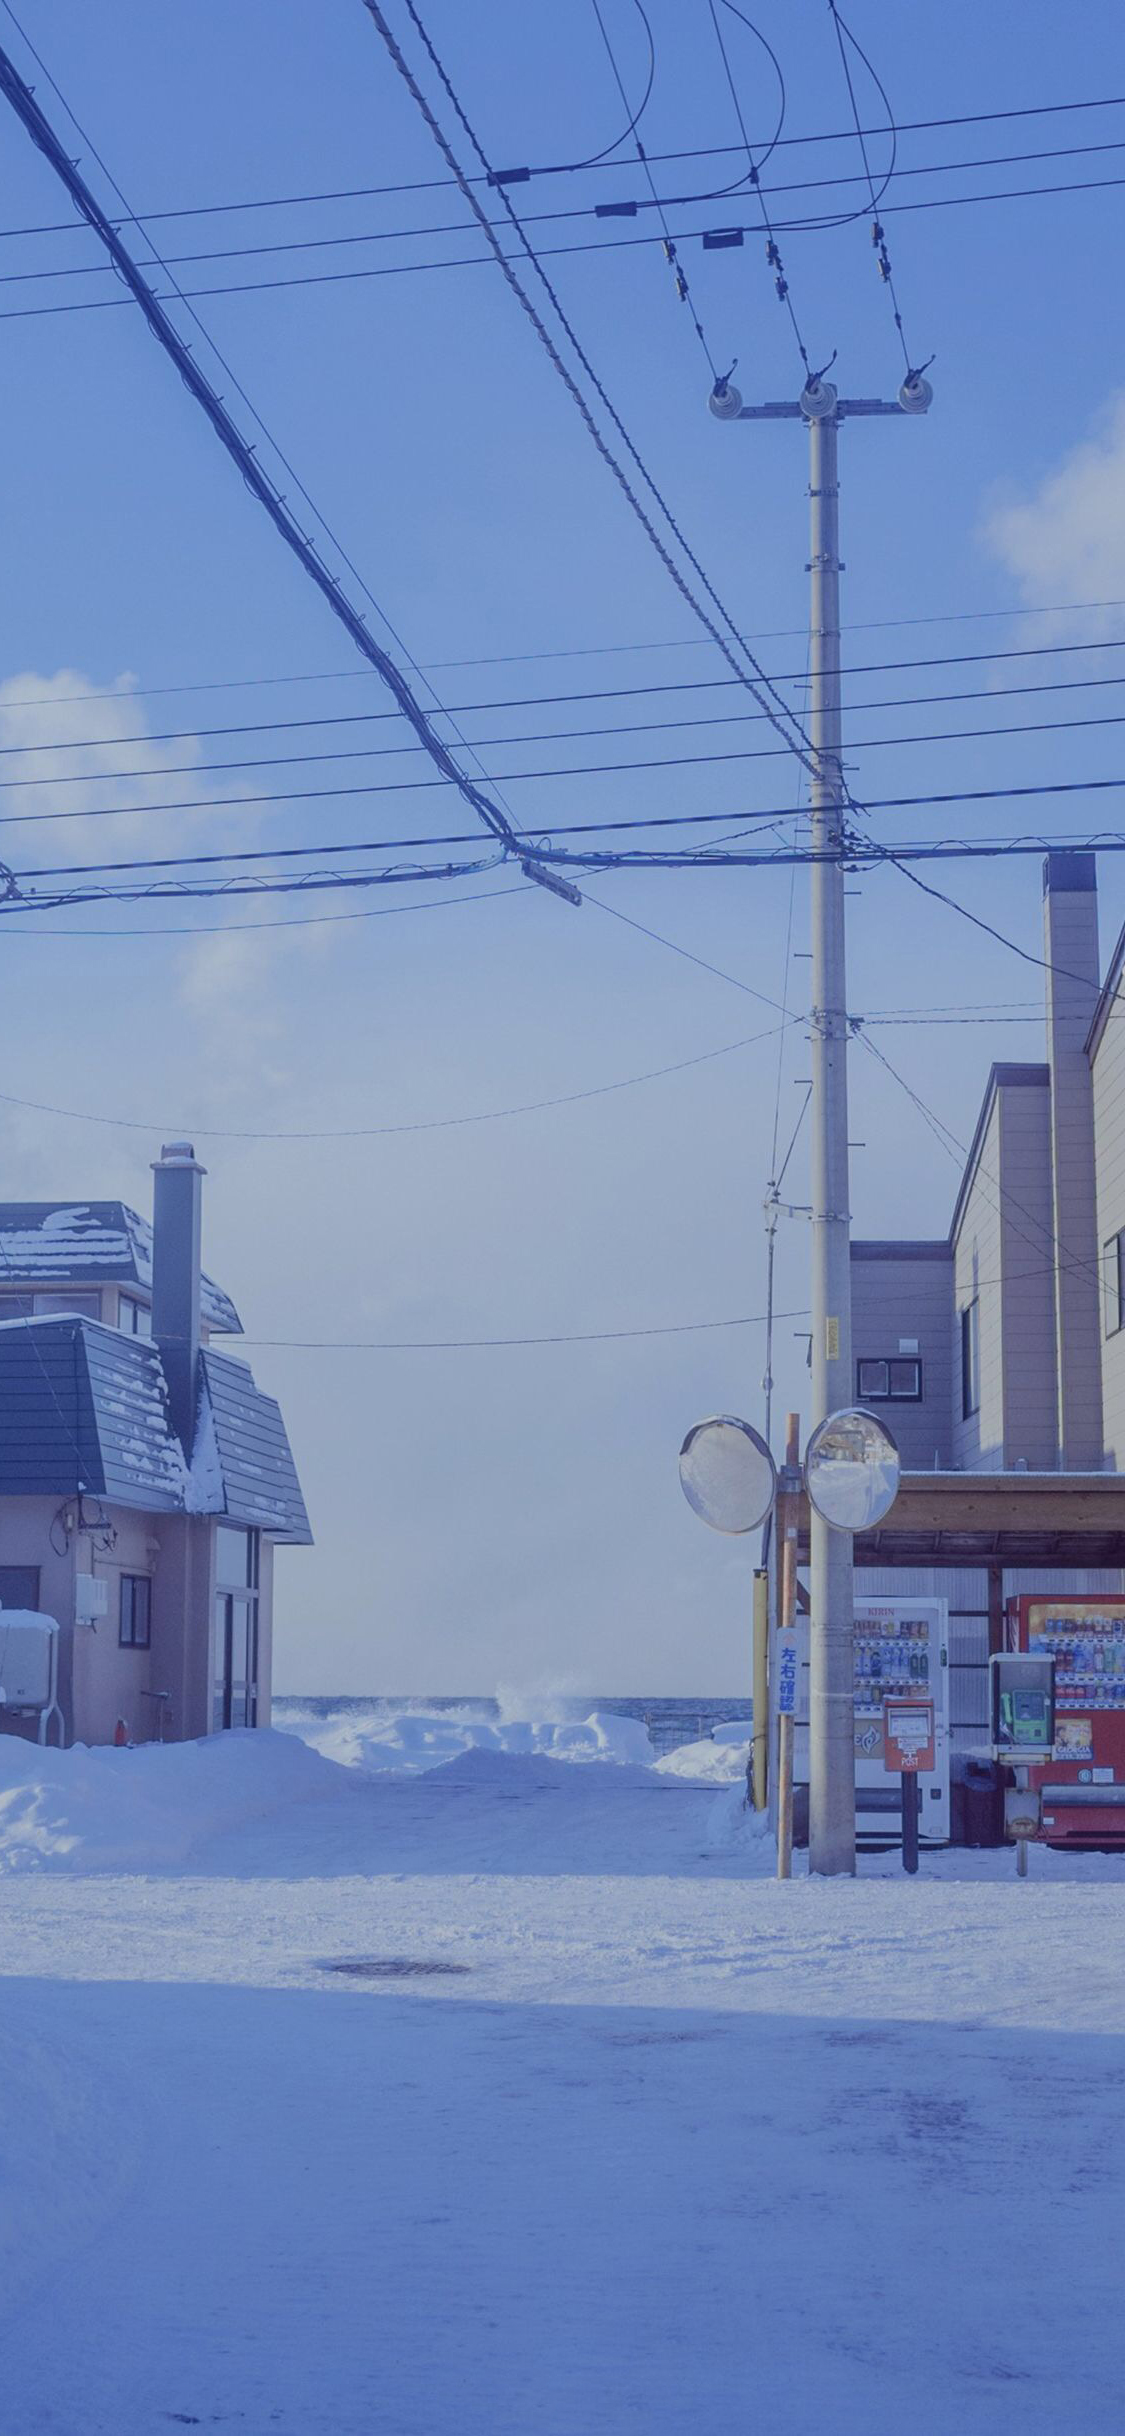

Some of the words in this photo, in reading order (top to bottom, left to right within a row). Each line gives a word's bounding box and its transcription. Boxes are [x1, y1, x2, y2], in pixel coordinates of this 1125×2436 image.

[868, 1607, 895, 1617] KIRIN
[780, 1647, 797, 1712] 左右確認
[901, 1756, 918, 1767] POST
